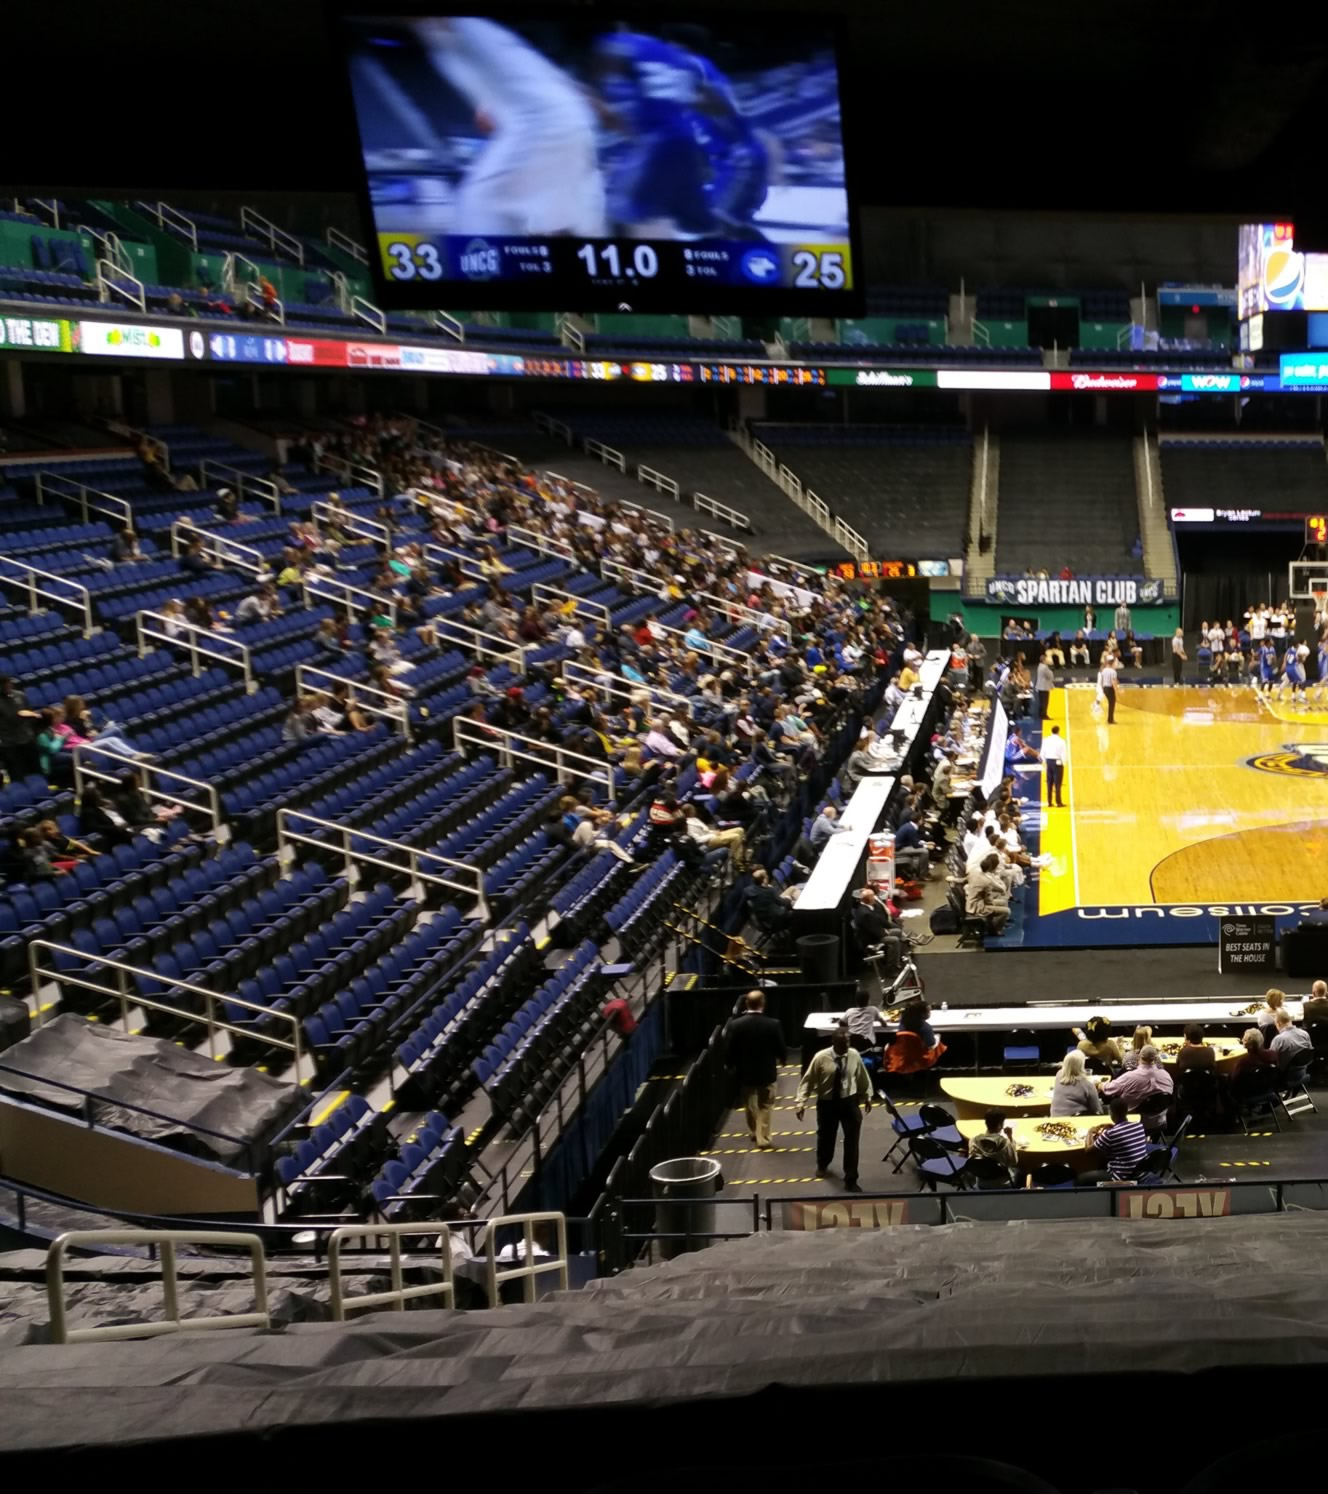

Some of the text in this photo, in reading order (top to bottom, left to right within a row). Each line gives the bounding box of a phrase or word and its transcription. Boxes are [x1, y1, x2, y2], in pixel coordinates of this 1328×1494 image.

[389, 242, 443, 279] 33
[460, 248, 498, 273] UNCG
[577, 243, 659, 278] 11.0
[793, 250, 845, 288] 25
[1072, 374, 1137, 389] Budweiser
[1017, 580, 1092, 604] SPARTAN
[1096, 580, 1137, 604] CLUB
[1225, 943, 1271, 952] BEST SEATS IN
[1230, 954, 1267, 963] THE HOUSE
